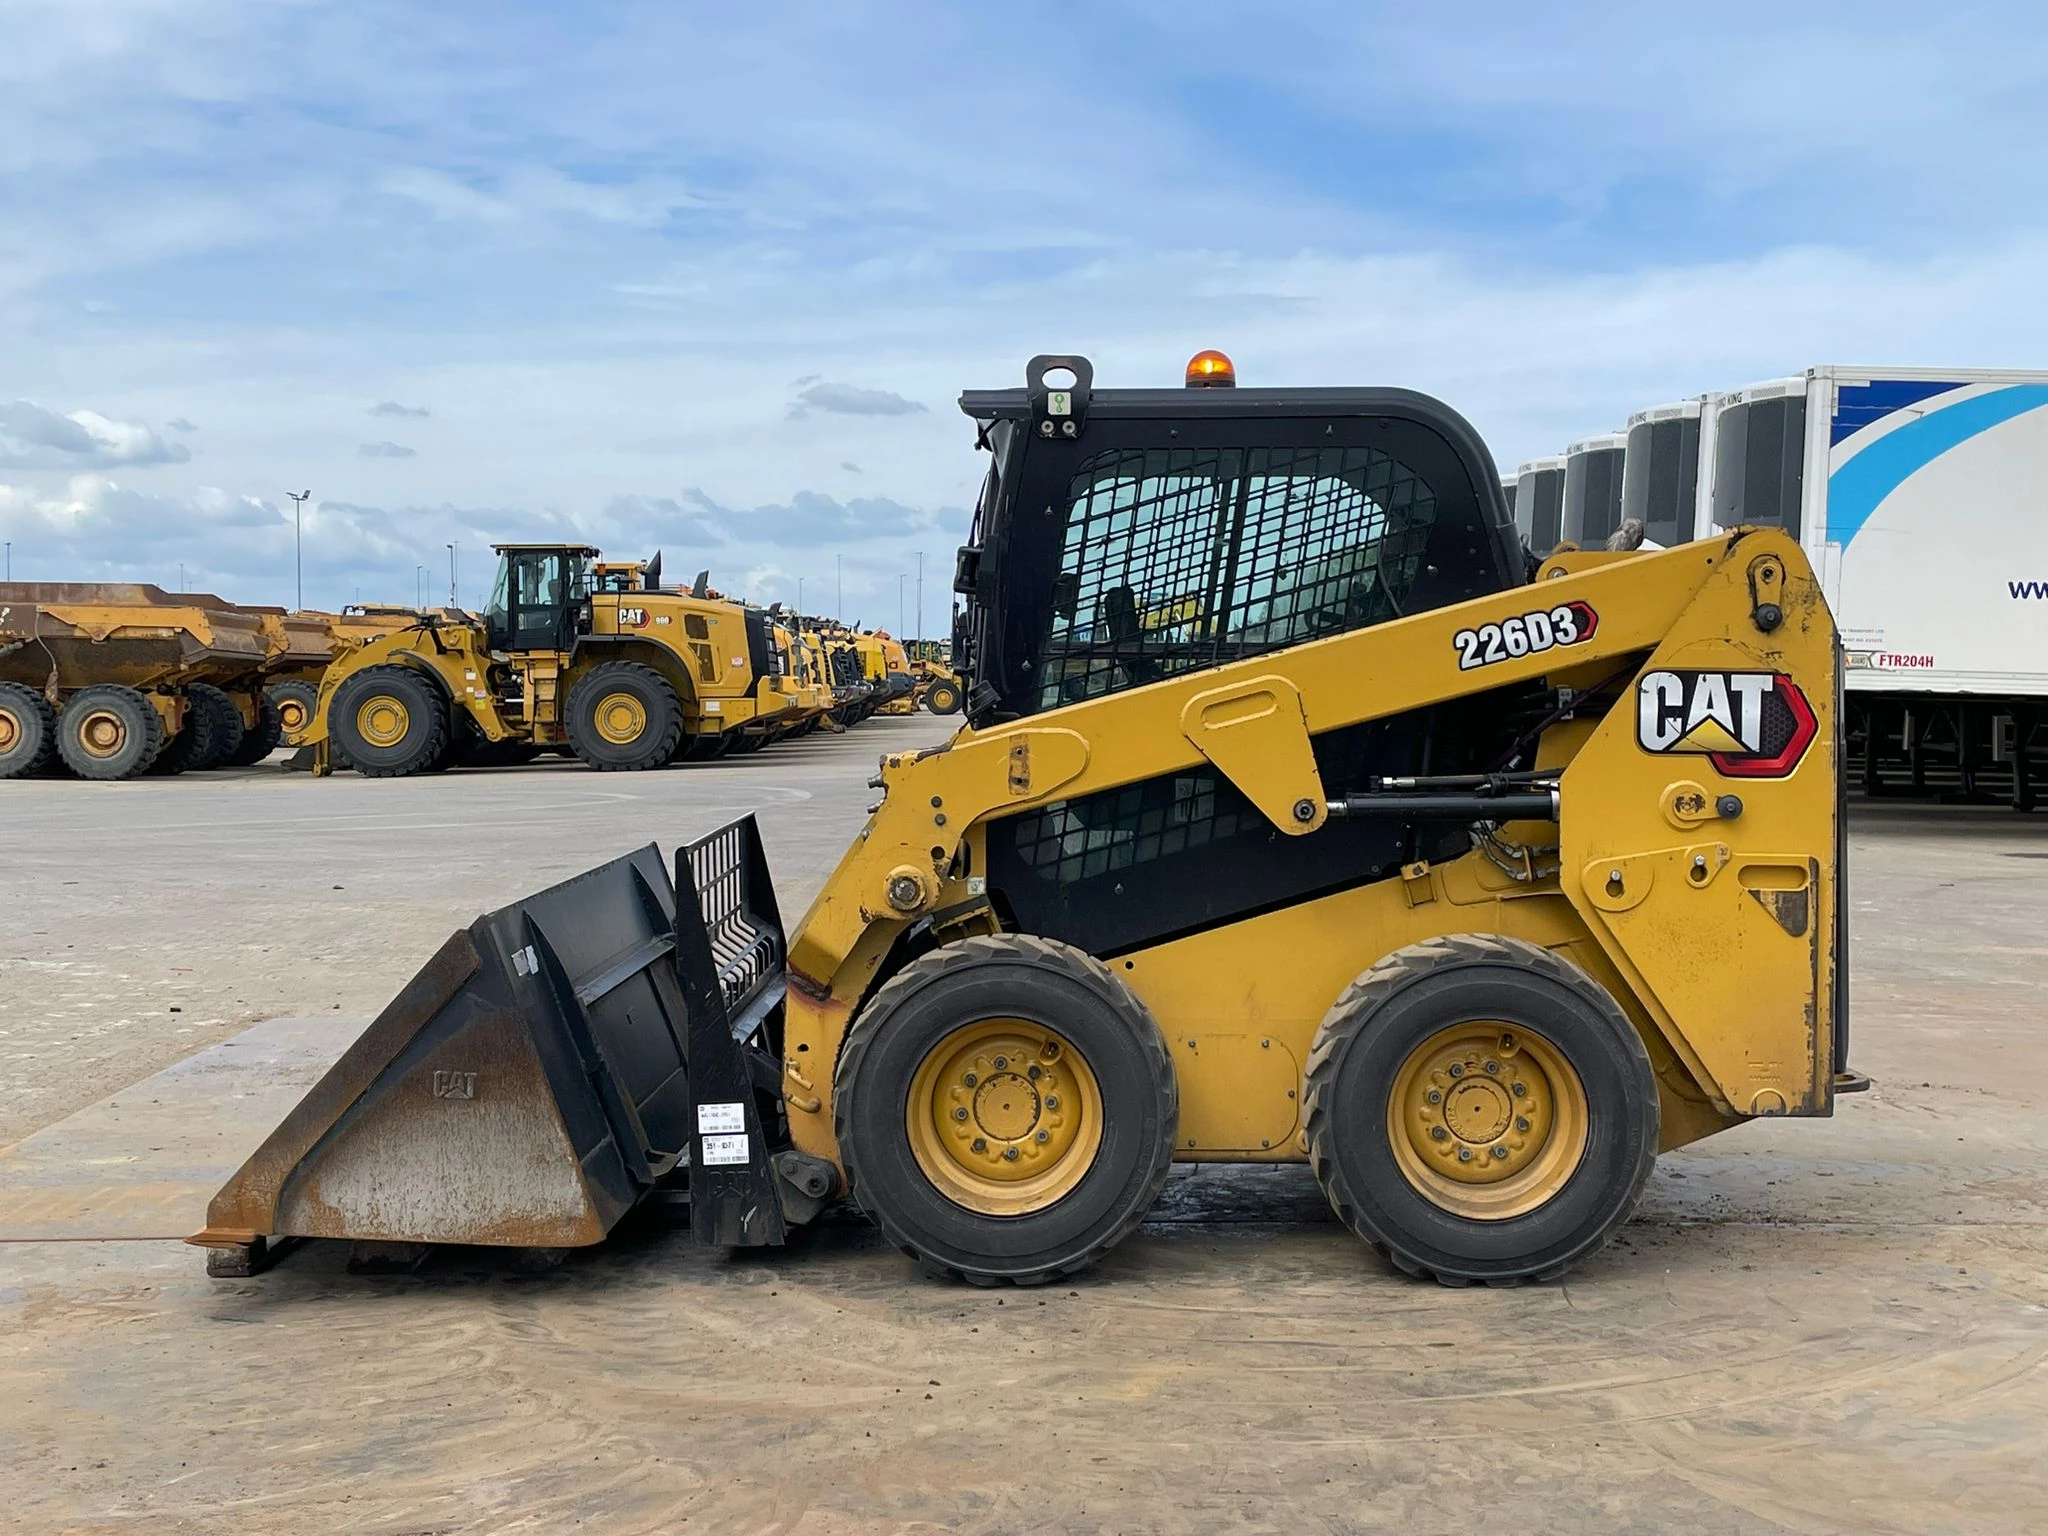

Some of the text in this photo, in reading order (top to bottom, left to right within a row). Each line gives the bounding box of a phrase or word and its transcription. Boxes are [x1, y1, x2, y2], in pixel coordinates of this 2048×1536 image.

[619, 608, 643, 624] CAT
[1454, 605, 1578, 670] 226D3
[1879, 654, 1934, 668] FTR204H
[1639, 671, 1774, 753] CAT
[432, 1070, 477, 1099] CAT
